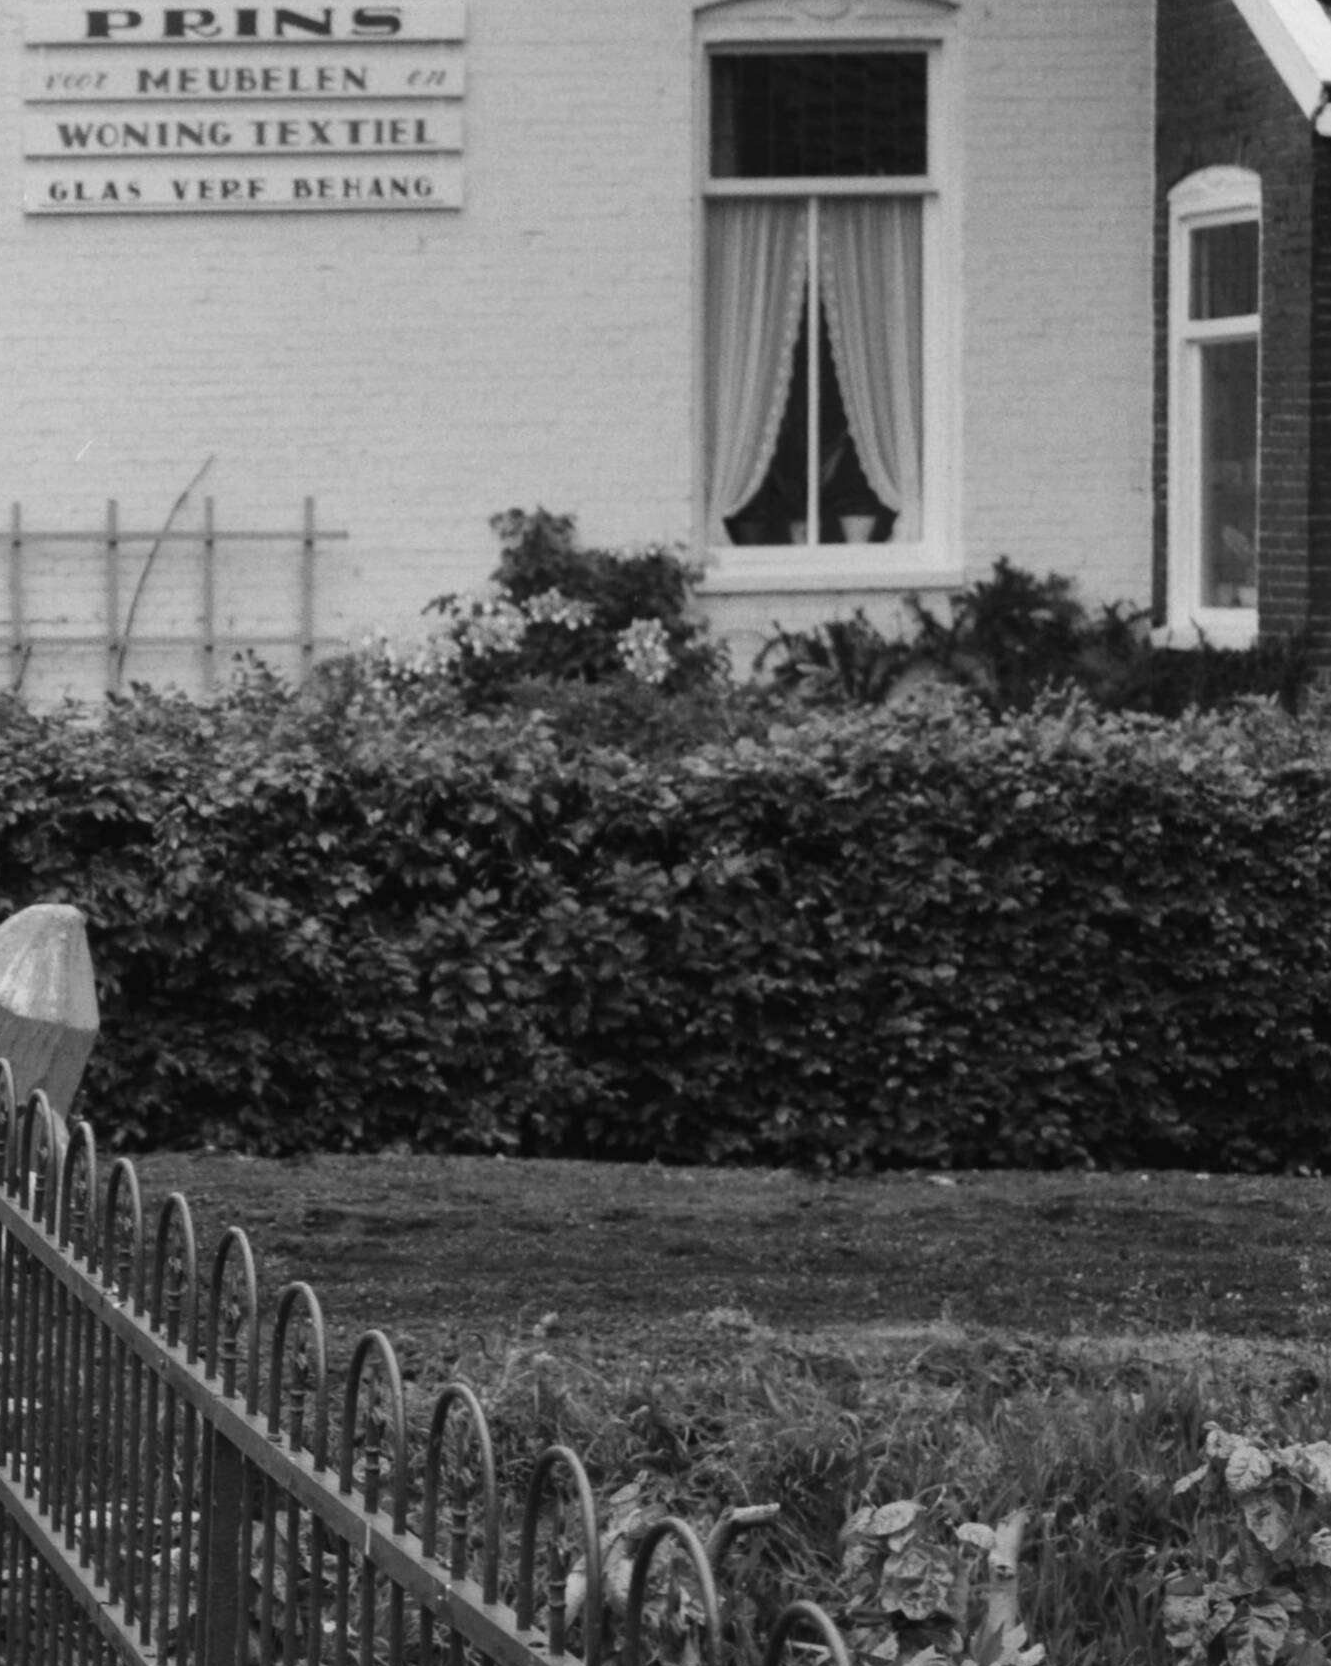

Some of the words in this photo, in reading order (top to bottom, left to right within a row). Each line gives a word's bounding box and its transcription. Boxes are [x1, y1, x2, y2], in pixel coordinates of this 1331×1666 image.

[85, 7, 402, 39] PRINS
[138, 66, 368, 93] MEUBELEN
[57, 121, 232, 148] WONING
[249, 118, 436, 146] TEXTIEL
[49, 182, 142, 201] GLAS
[172, 178, 265, 200] VERF
[293, 176, 433, 199] BEHANG
